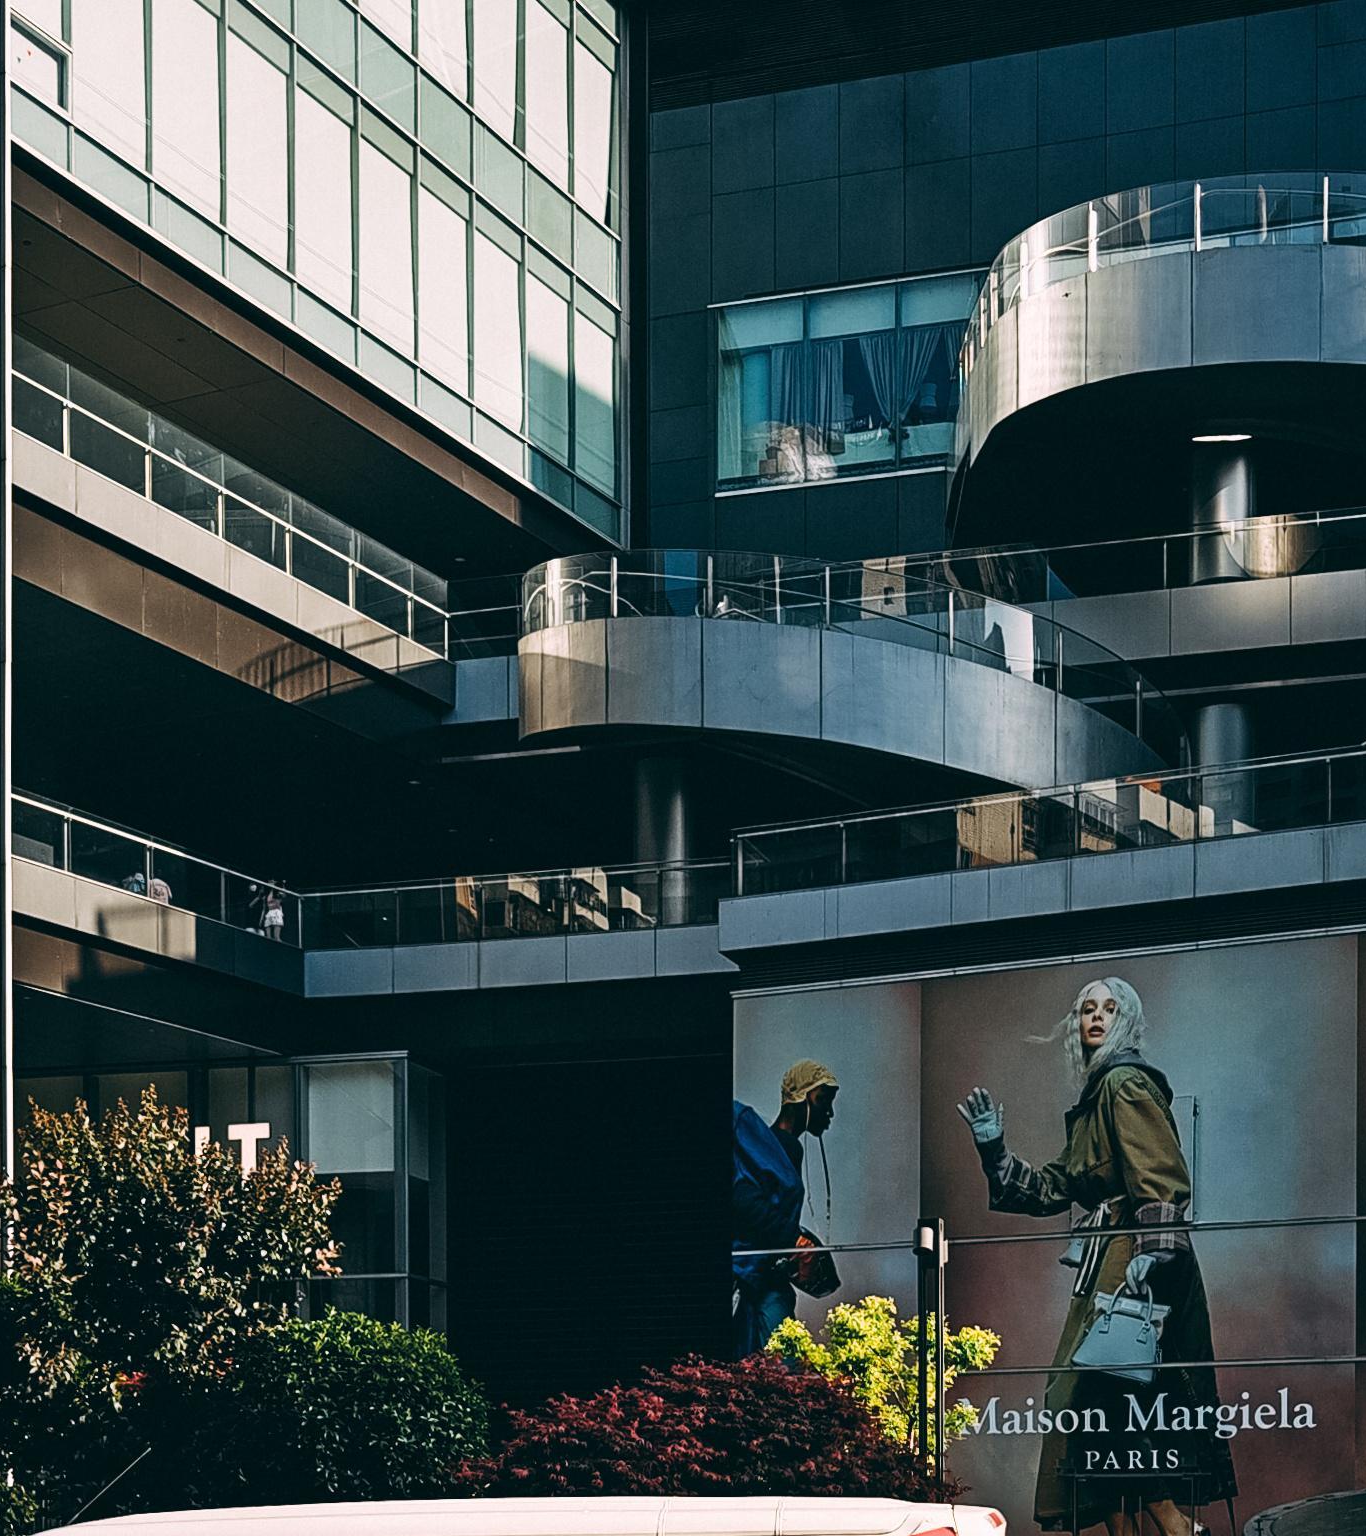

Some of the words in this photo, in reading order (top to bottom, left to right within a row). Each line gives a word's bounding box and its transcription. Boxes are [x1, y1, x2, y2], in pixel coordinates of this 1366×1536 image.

[956, 1397, 1109, 1435] Maison
[1123, 1387, 1317, 1439] Margiela
[1085, 1449, 1180, 1470] PARIS
